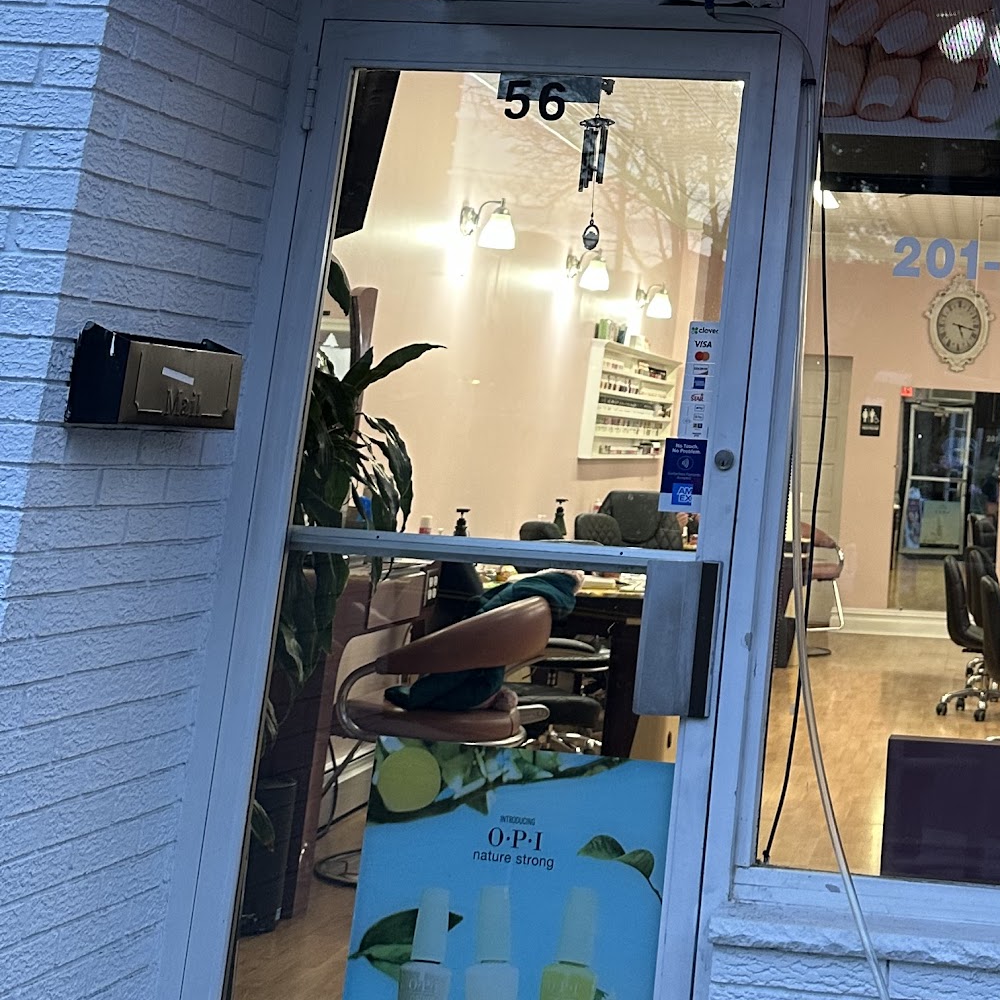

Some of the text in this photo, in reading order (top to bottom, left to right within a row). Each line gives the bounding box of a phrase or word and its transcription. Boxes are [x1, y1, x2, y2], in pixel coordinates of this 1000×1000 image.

[504, 80, 568, 121] 56
[694, 340, 712, 348] VISA
[166, 388, 202, 418] Mail
[500, 815, 536, 826] INTRODUCING
[473, 850, 554, 871] nature strong
